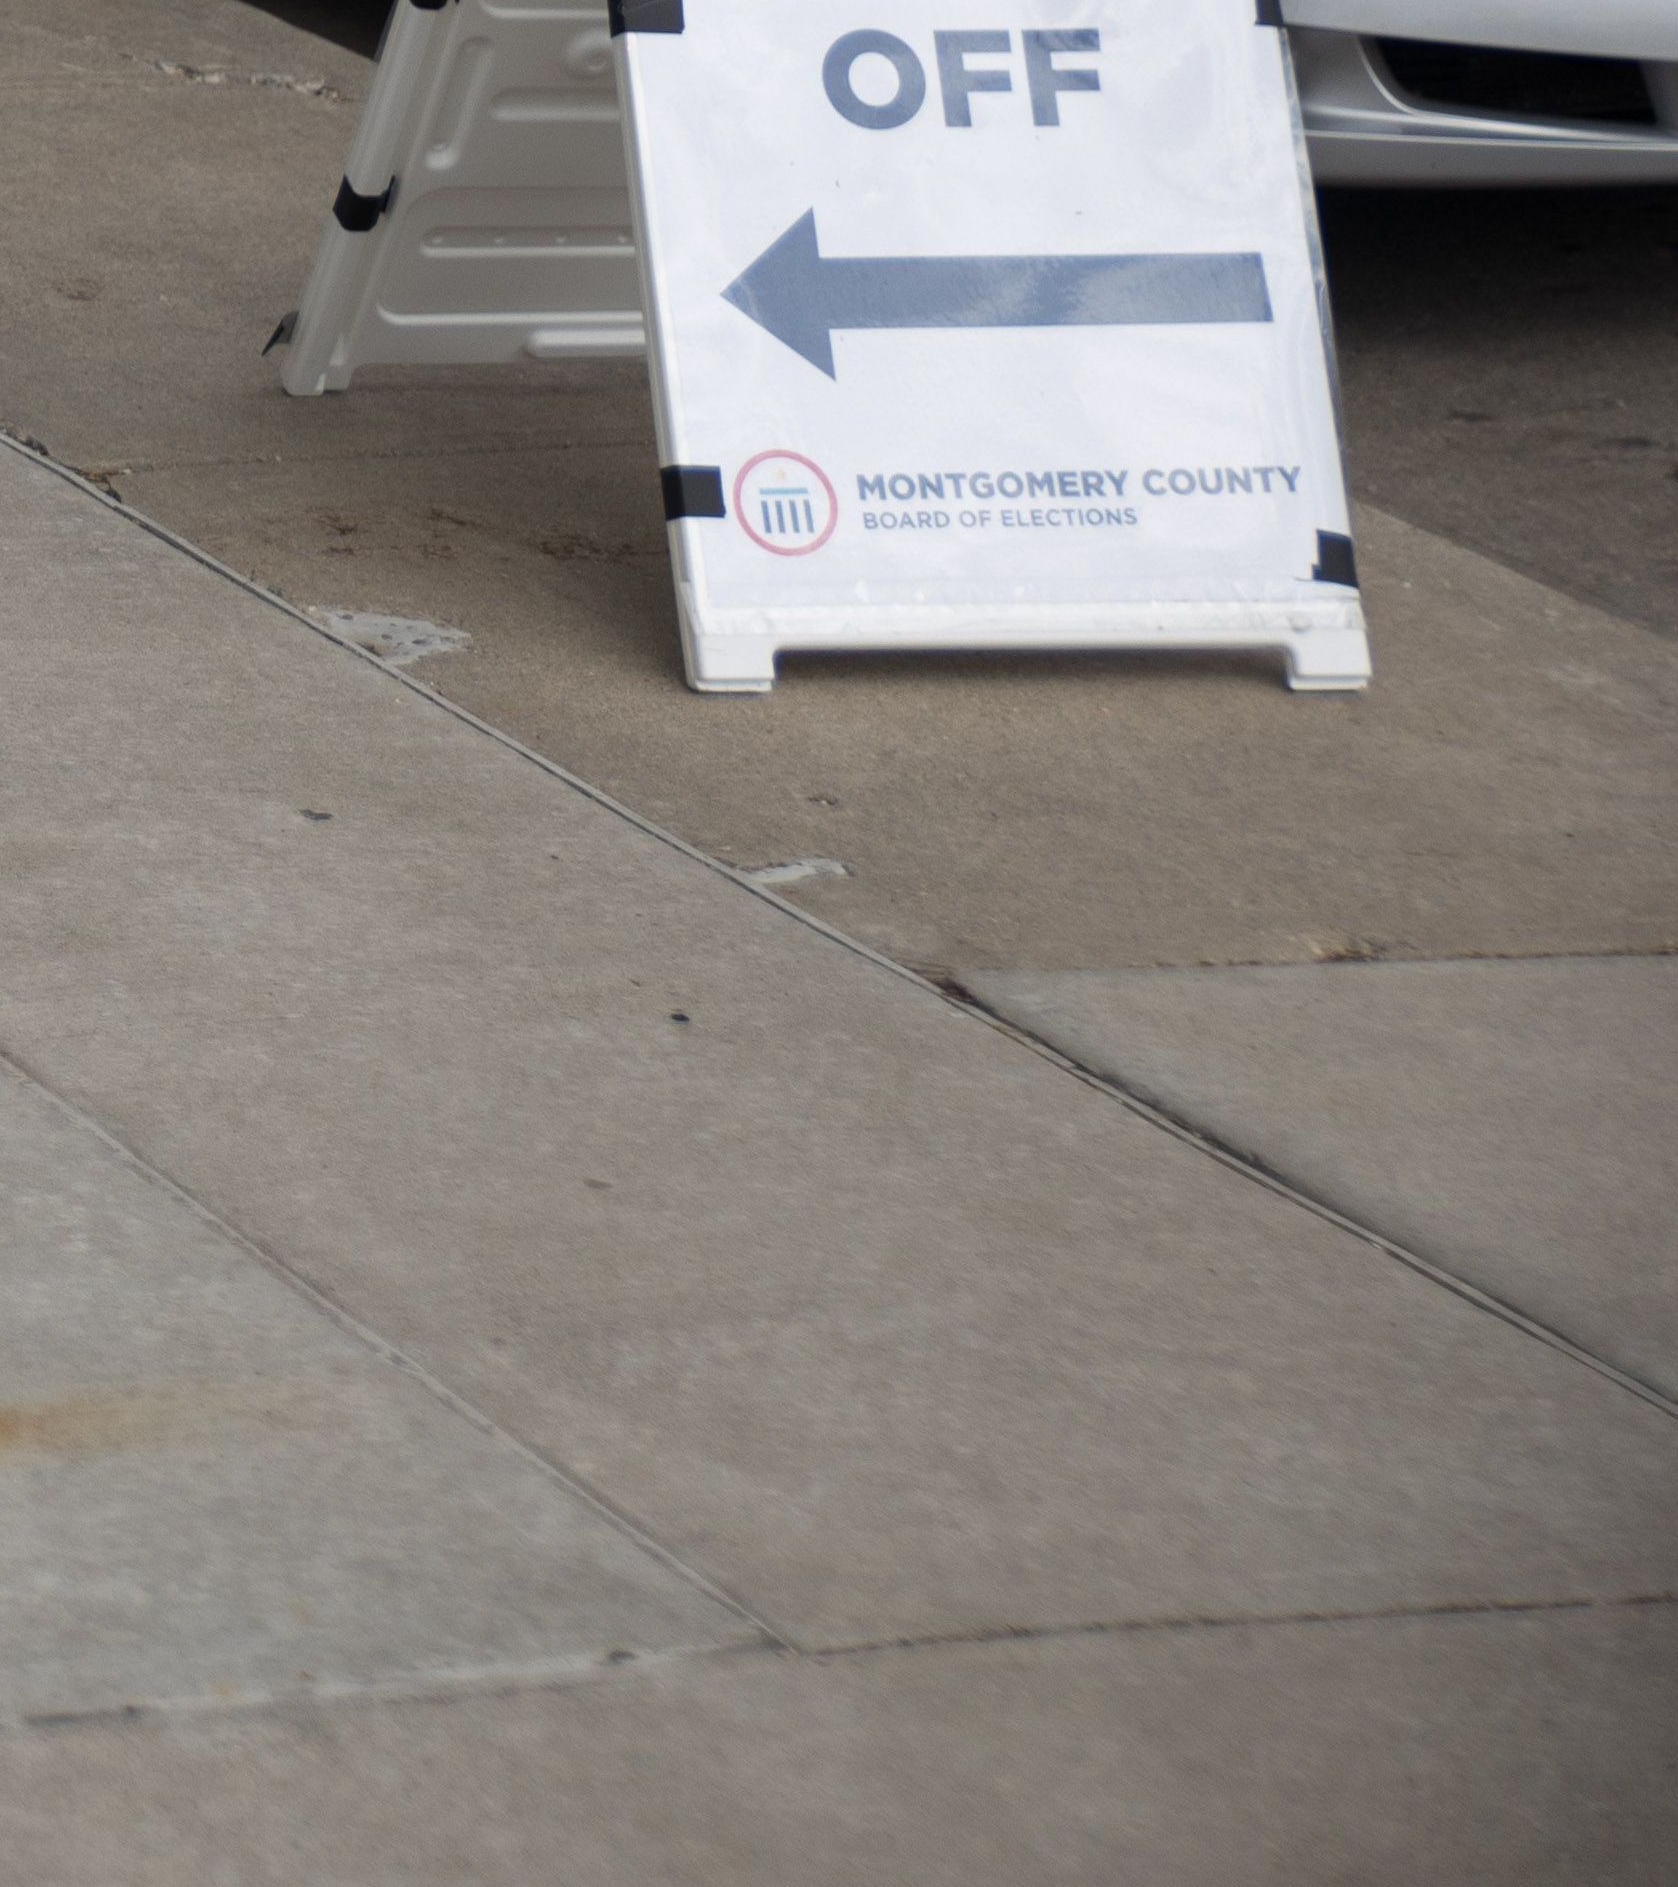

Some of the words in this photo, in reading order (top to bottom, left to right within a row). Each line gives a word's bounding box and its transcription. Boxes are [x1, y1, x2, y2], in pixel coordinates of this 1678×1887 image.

[822, 28, 1101, 130] OFF
[856, 469, 1129, 501] MONTGOMERY
[1142, 465, 1301, 497] COUNTY
[862, 509, 951, 530] BOARD
[962, 509, 993, 529] OF
[1001, 507, 1139, 529] ELECTIONS
